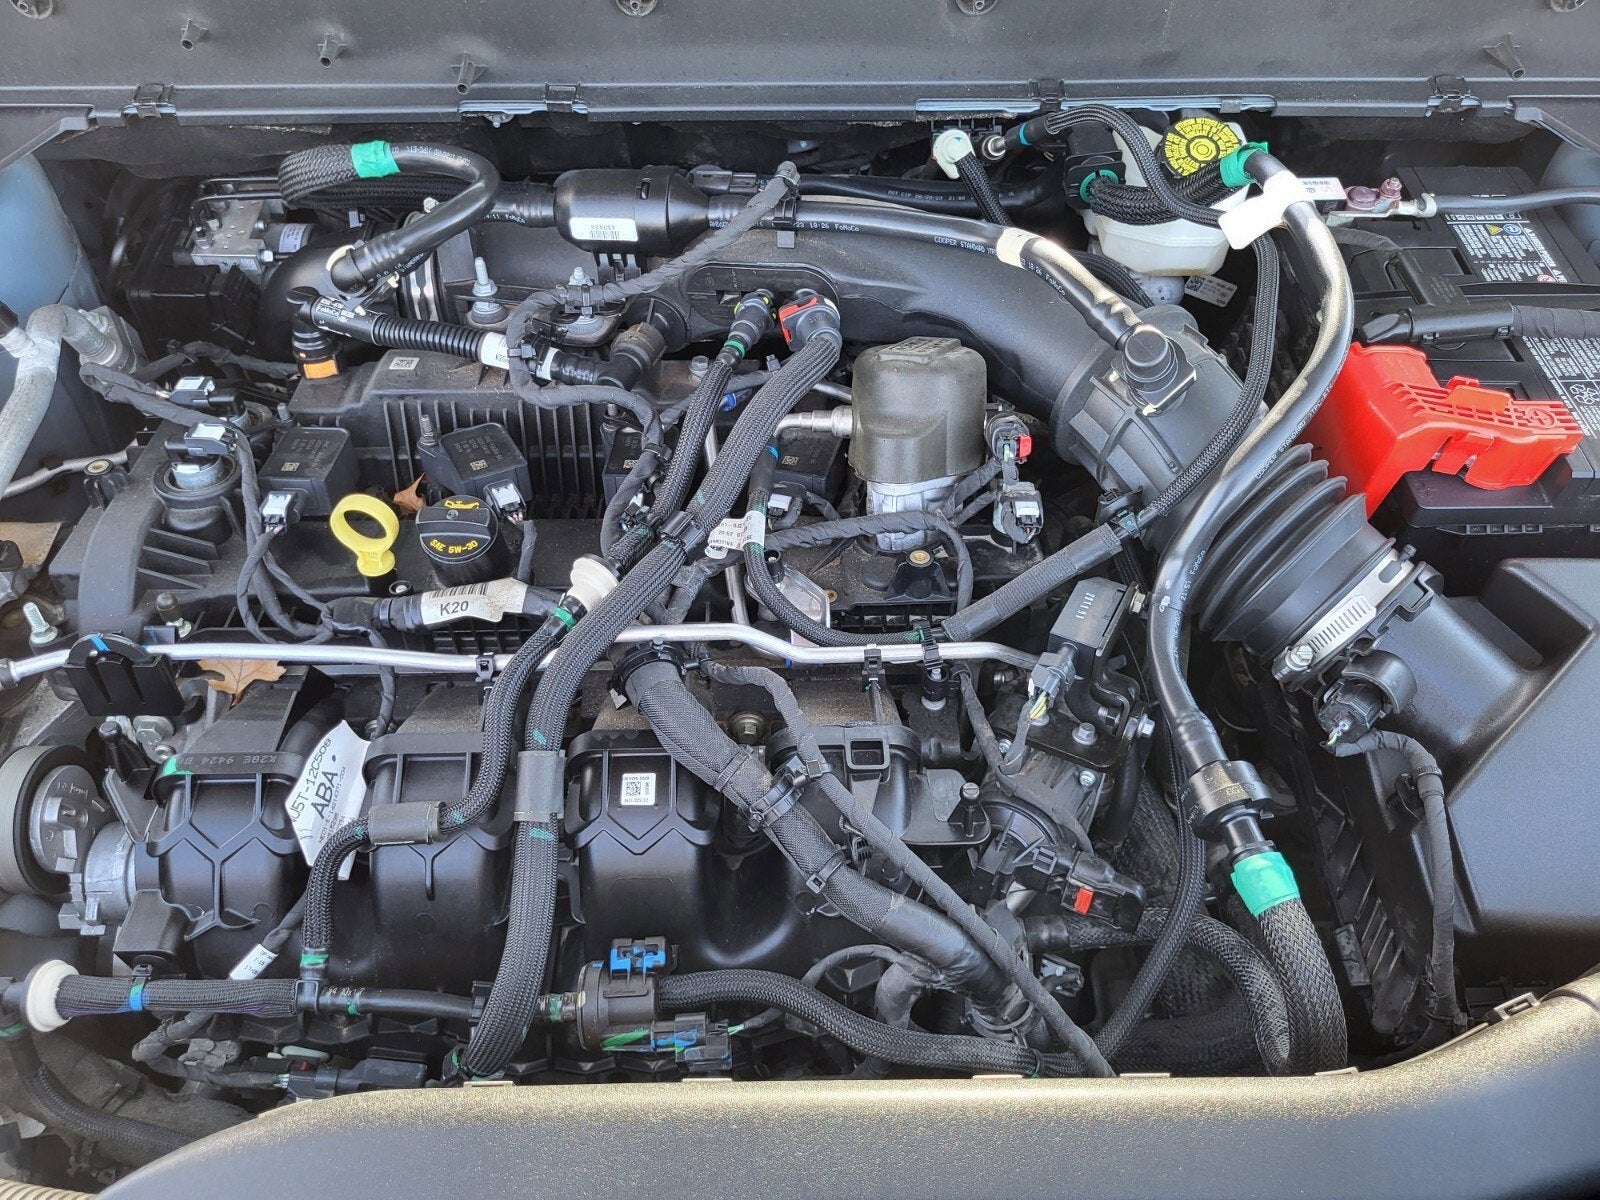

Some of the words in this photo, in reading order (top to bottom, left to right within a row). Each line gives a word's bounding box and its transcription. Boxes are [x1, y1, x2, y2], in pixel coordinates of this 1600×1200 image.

[834, 223, 860, 232] FoMoCo
[934, 235, 958, 246] COOPER
[960, 240, 986, 253] STANDARD
[1045, 273, 1066, 296] FoMoCo
[1254, 452, 1279, 480] COOPER
[1278, 420, 1306, 453] STANDARD
[430, 539, 446, 552] SAE
[448, 539, 479, 554] 5W-30
[1189, 549, 1206, 576] FoMoCo
[440, 600, 469, 617] K20
[200, 754, 235, 765] 9424
[310, 770, 339, 819] ABA
